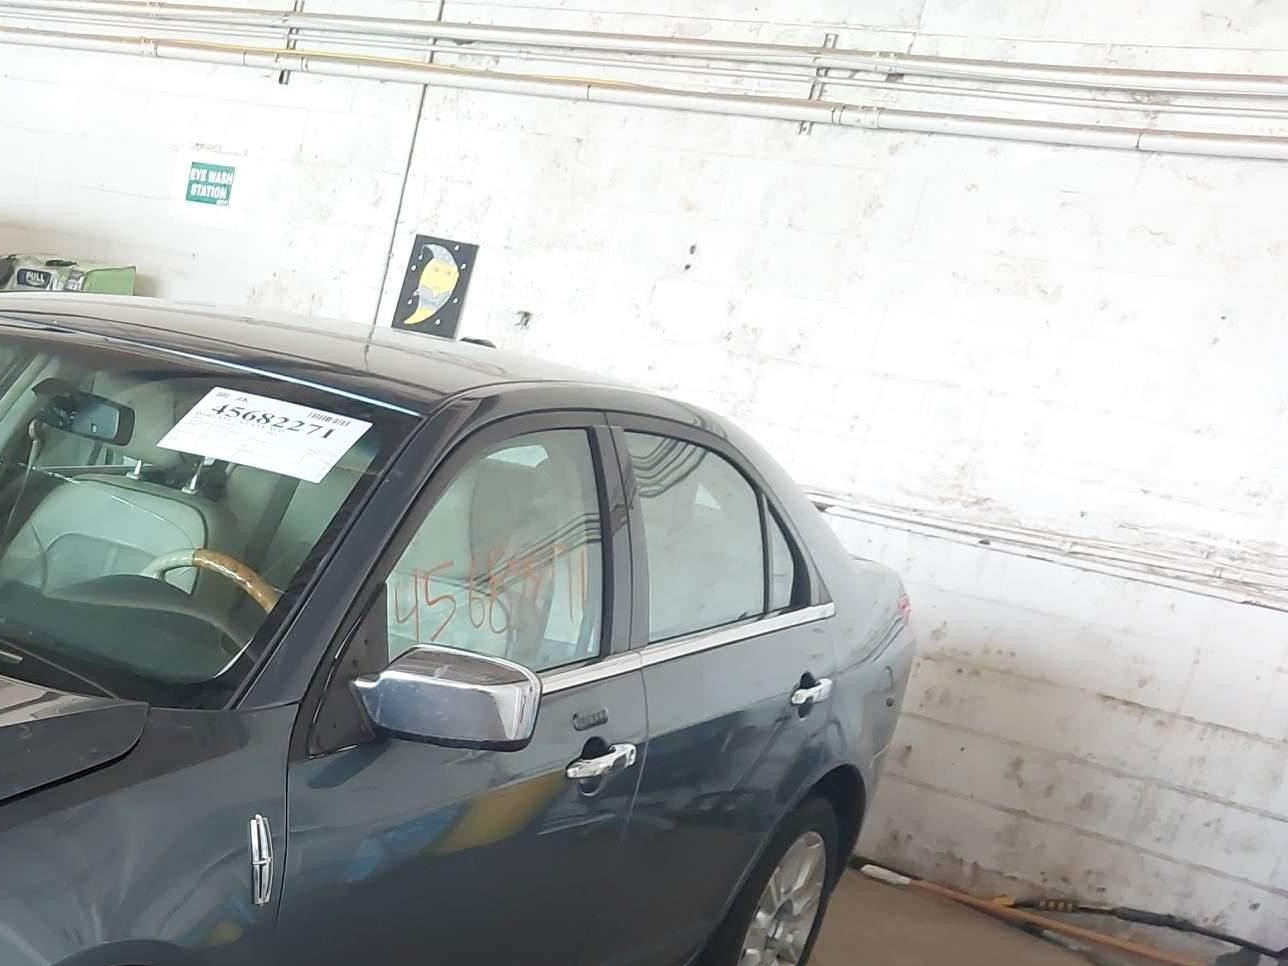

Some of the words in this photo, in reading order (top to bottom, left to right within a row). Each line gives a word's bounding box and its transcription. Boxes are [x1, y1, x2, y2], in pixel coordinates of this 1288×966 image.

[191, 167, 208, 182] EYE
[208, 169, 234, 185] WASH
[190, 183, 228, 199] STATION
[26, 271, 45, 282] PULL
[211, 403, 337, 440] 45682271
